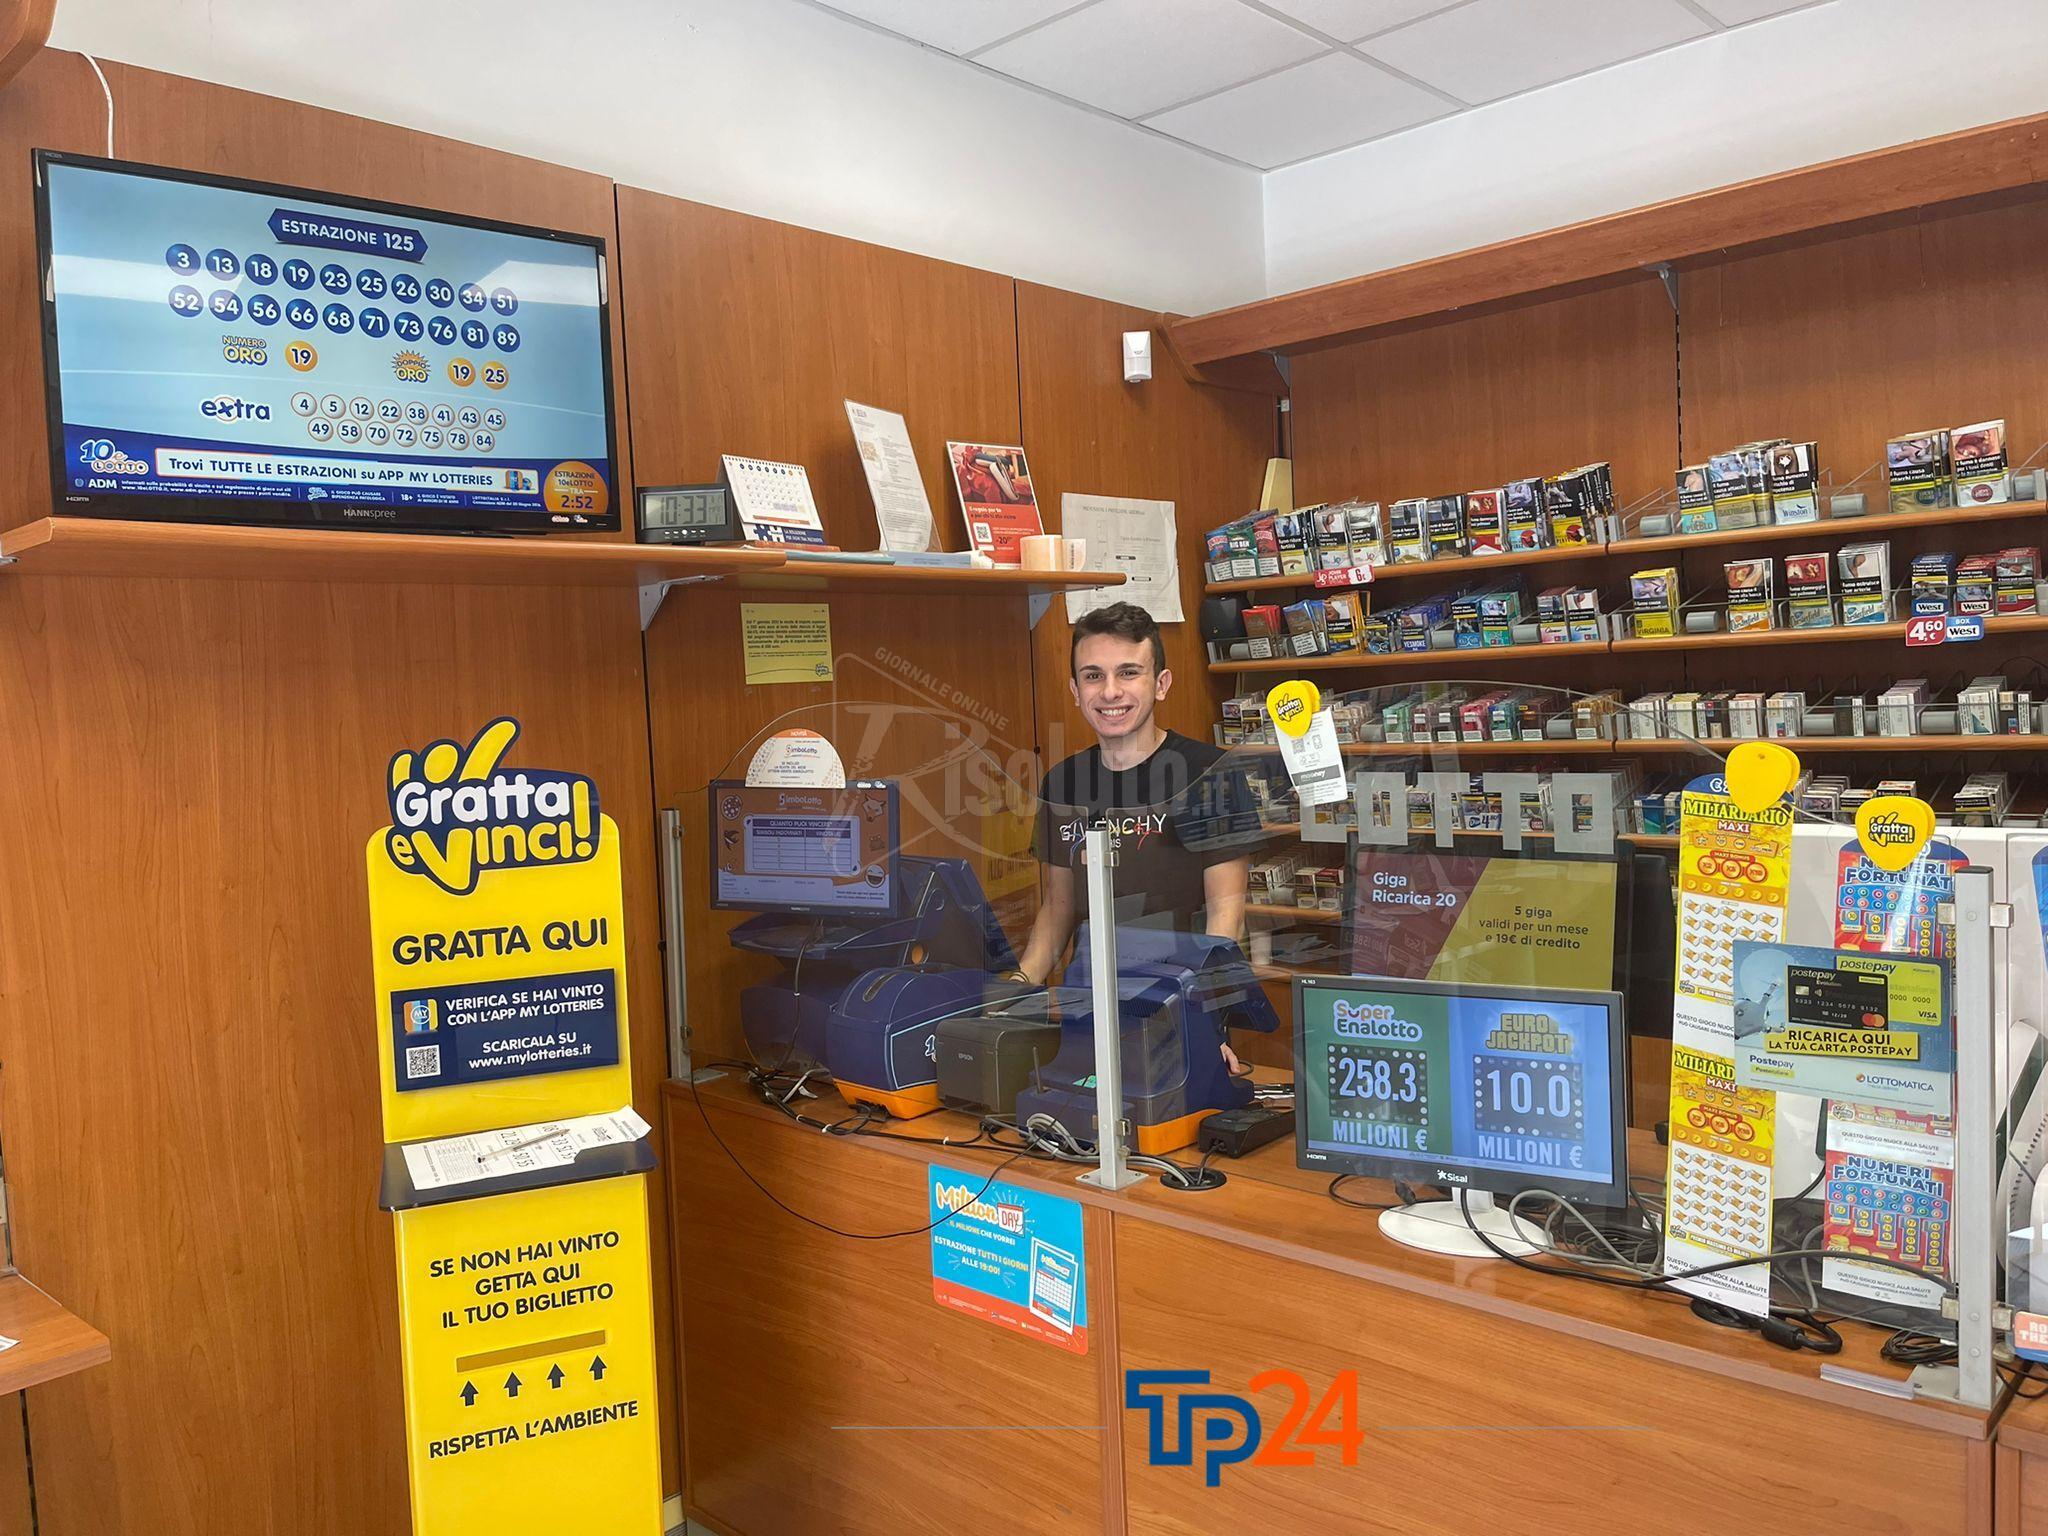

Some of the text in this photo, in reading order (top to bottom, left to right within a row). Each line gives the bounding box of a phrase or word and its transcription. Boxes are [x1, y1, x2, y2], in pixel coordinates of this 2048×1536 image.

[281, 219, 415, 252] ESTRAZIONE 125
[177, 252, 513, 310] 3 13 18 19 23 25 26 30 34 51
[173, 293, 517, 347] 52 54 56 66 68 71 73 76 81 89
[222, 335, 266, 348] NUMERO
[223, 345, 312, 365] ORO 19
[396, 364, 506, 384] ORO 19 25
[200, 398, 271, 421] extra
[299, 398, 502, 426] 4 5 12 22 38 41 43 45
[311, 422, 492, 447] 49 58 70 72 75 78 84
[169, 458, 493, 486] Trovi TUTTE LE ESTRAZIONI su APP MY LOTTERIES
[554, 470, 595, 480] ESTRAZIONE
[88, 478, 117, 489] ADM
[570, 487, 584, 495] TRA
[401, 493, 413, 501] 18+
[561, 494, 593, 509] 2:52
[343, 508, 396, 520] HANNspree
[1783, 508, 1808, 519] Winston
[1918, 603, 1942, 611] West
[1963, 602, 1988, 610] West
[1949, 627, 1977, 636] West
[396, 774, 571, 828] Gratta
[1718, 820, 1750, 833] MAXI
[1870, 822, 1909, 835] Gratta
[391, 834, 415, 866] e
[1373, 871, 1407, 889] Giga
[1372, 889, 1457, 908] Ricarica 20
[1514, 906, 1552, 920] 5 giga
[1479, 918, 1589, 936] validi per un mese
[392, 917, 608, 965] GRATTA QUI
[1485, 933, 1581, 950] e 19€ di credito
[1791, 969, 1836, 981] postepay
[1840, 959, 1897, 974] postepay
[446, 983, 604, 1012] VERIFICA SE HAI VINTO
[446, 998, 605, 1027] CON L'APP MY LOTTERIES
[1337, 1002, 1391, 1021] Super
[1918, 1011, 1938, 1020] VISA
[1337, 1018, 1419, 1039] Enalotto
[1500, 1013, 1550, 1034] EURO
[482, 1032, 577, 1054] SCARICALA SU
[1486, 1031, 1570, 1055] JACKPOT
[1788, 1029, 1891, 1046] RICARICA QUI
[468, 1043, 592, 1070] www.mylotteries.it
[1769, 1041, 1913, 1056] LA TUA CARTA POSTEPAY
[1749, 1054, 1795, 1069] Postepay
[1338, 1057, 1417, 1102] 258.3
[1866, 1075, 1935, 1092] LOTTOMATICA
[1487, 1069, 1571, 1118] 10.0
[1333, 1120, 1428, 1151] MILIONI €
[1478, 1135, 1560, 1167] MILIONI
[1569, 1145, 1584, 1169] €
[1847, 1155, 1932, 1179] NUMERI
[1446, 1173, 1468, 1184] Sisal
[1833, 1165, 1944, 1197] FORTUNATI
[1002, 1211, 1020, 1232] DAY
[993, 1232, 1016, 1246] VORREI
[429, 1231, 620, 1278] SE NON HAI VINTO
[934, 1235, 1029, 1272] ESTRAZIONE TUTTI GIORNI
[961, 1256, 979, 1269] ALLE
[475, 1263, 580, 1296] GETTA QUI
[442, 1283, 614, 1328] IL TUO BIGLIETTO
[429, 1400, 639, 1459] RISPETTA L'AMBIENTE
